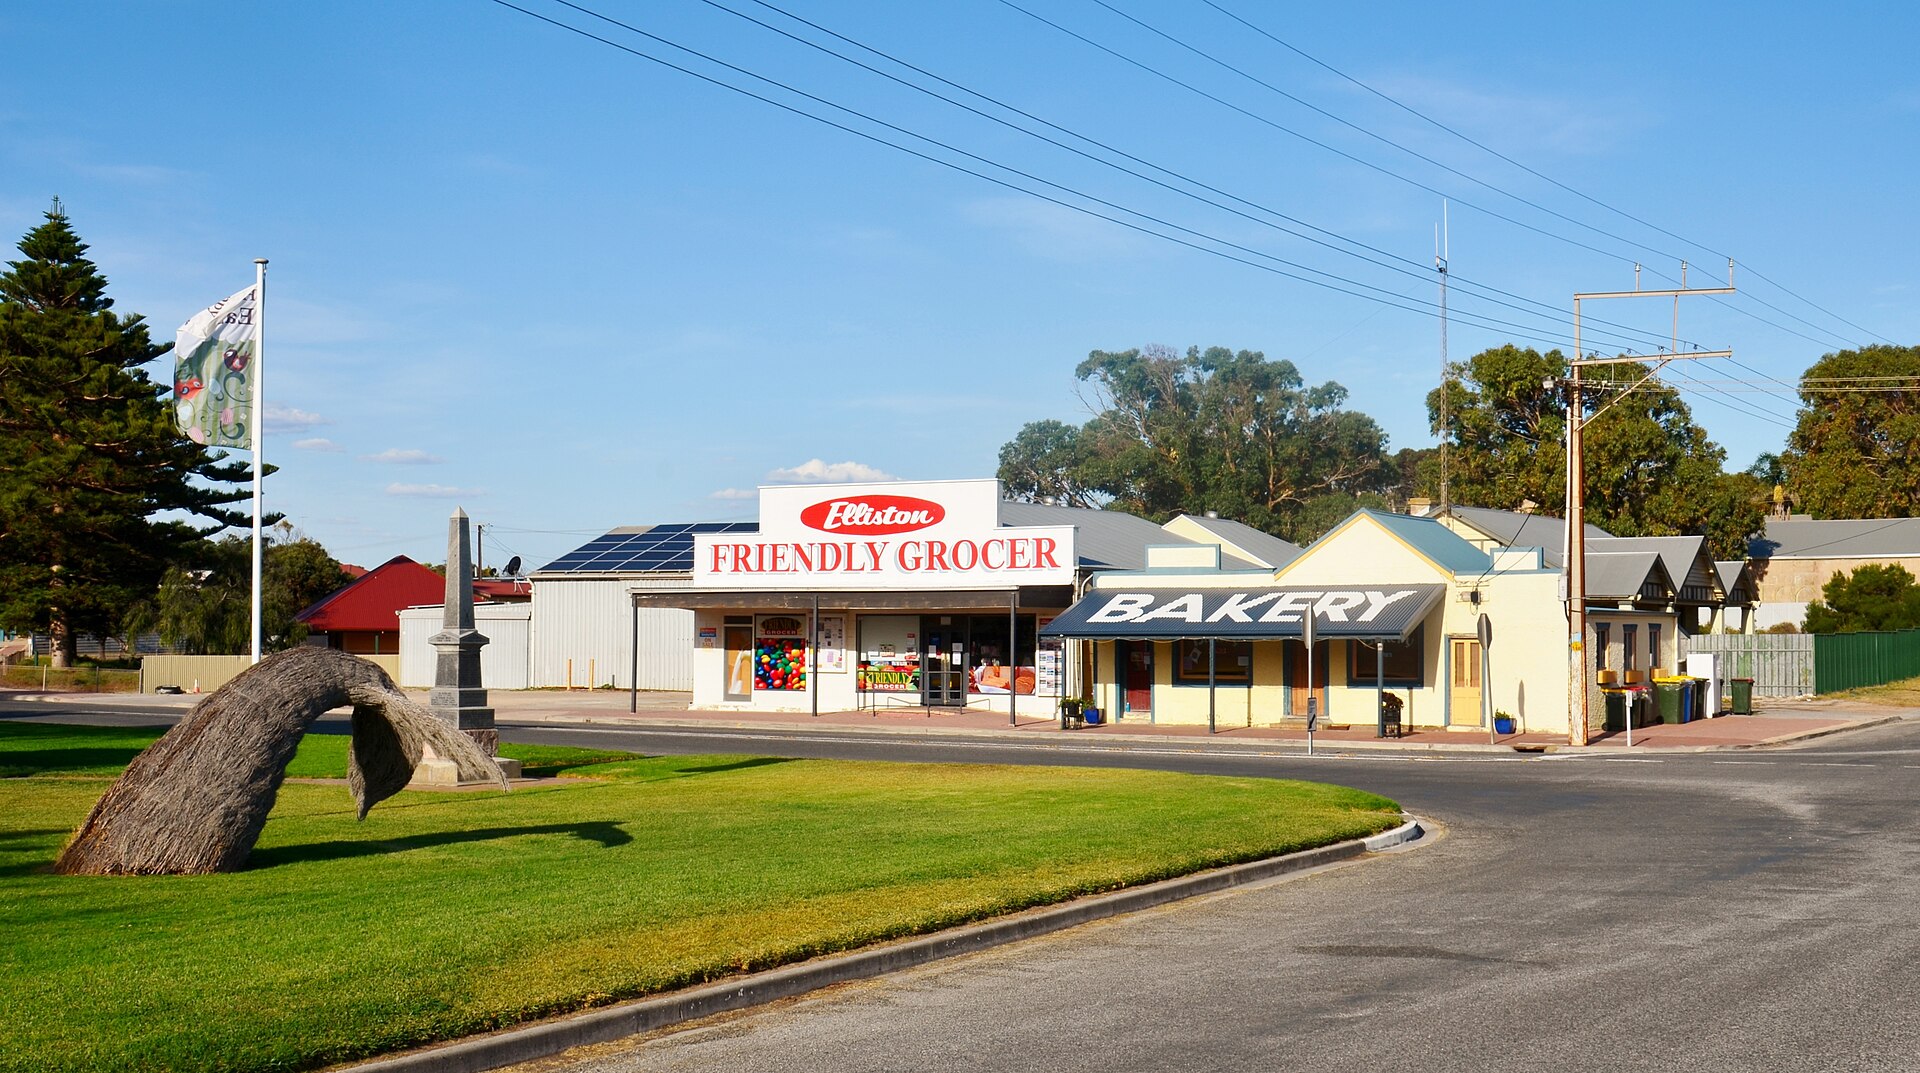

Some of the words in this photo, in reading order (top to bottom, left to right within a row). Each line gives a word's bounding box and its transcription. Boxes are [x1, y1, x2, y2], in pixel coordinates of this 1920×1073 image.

[823, 501, 934, 530] Elliston
[709, 540, 890, 574] FRIENDLY
[897, 537, 1062, 571] GROCER
[1086, 590, 1418, 624] BAKERY
[872, 672, 906, 684] FRIENDLY
